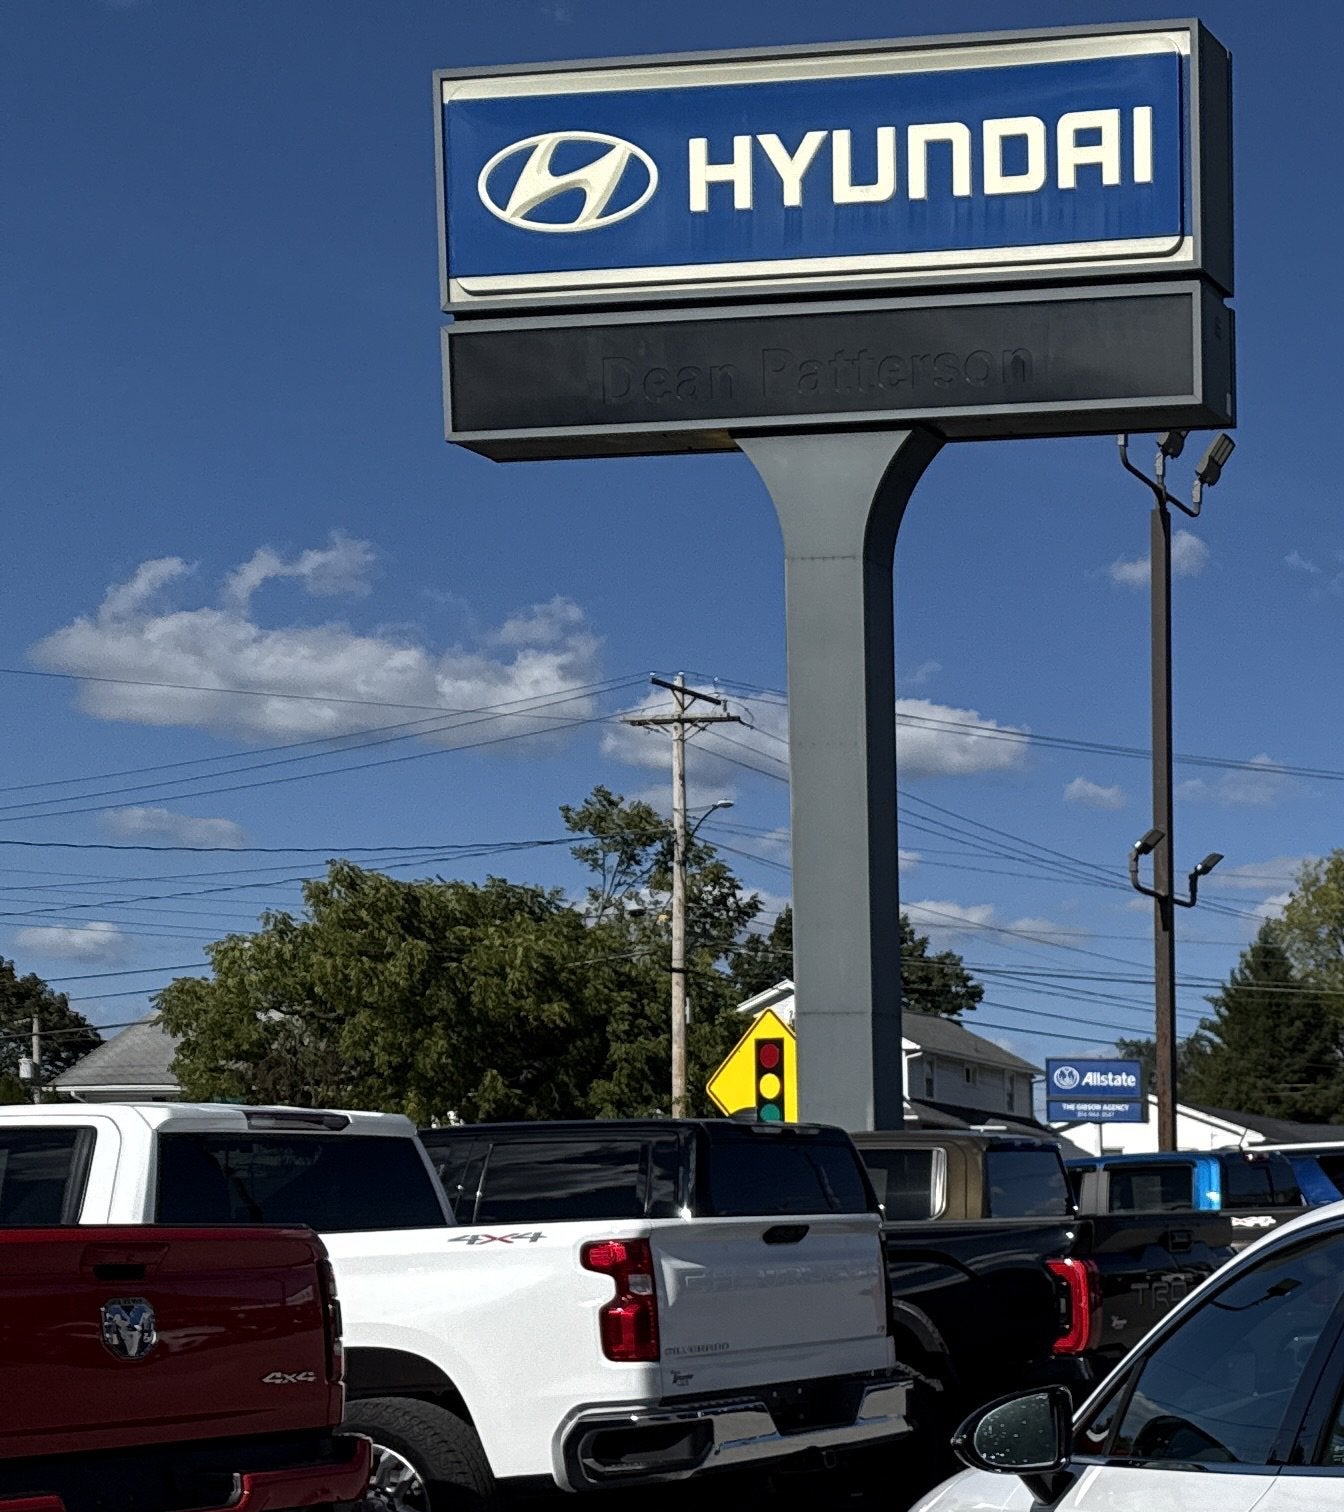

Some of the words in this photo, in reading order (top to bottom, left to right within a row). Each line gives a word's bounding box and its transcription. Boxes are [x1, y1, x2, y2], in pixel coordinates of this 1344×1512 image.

[688, 105, 1153, 212] HYUNDAI
[600, 353, 736, 406] Dean
[760, 341, 1036, 397] Patterson
[1081, 1071, 1136, 1087] Allstate
[664, 1342, 730, 1356] SILVERADO
